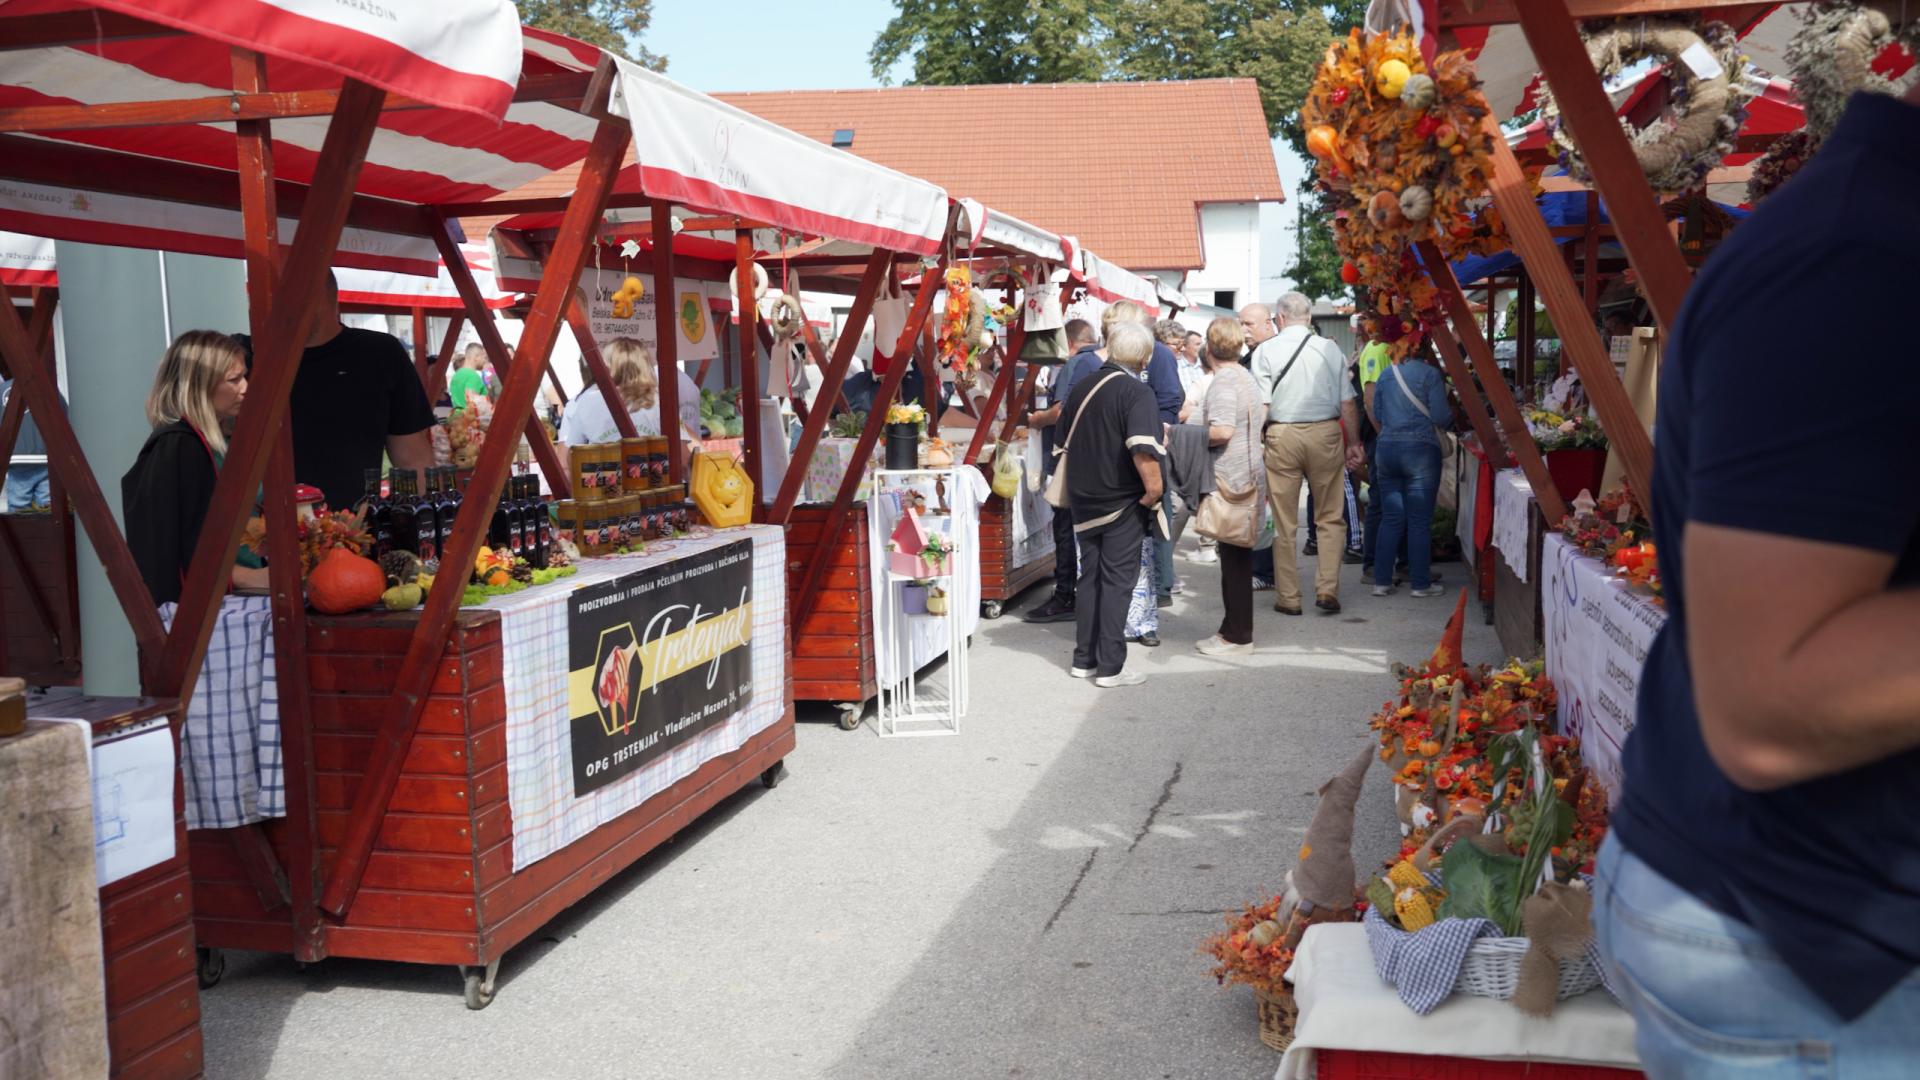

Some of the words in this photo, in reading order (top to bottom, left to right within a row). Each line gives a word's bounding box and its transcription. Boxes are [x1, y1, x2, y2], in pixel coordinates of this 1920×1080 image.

[579, 592, 626, 614] PROIZVODNJA
[626, 589, 631, 599] I
[631, 581, 655, 598] PRODAJA
[656, 573, 684, 588] PČELINJIH
[685, 562, 714, 579] PROIZVODA
[718, 554, 739, 569] BUČINOG
[642, 586, 749, 695] Trstenjak
[585, 757, 609, 777] OPG
[613, 730, 659, 765] TRSTENJAK
[665, 711, 701, 736] Vladimira
[703, 698, 728, 717] Nazora
